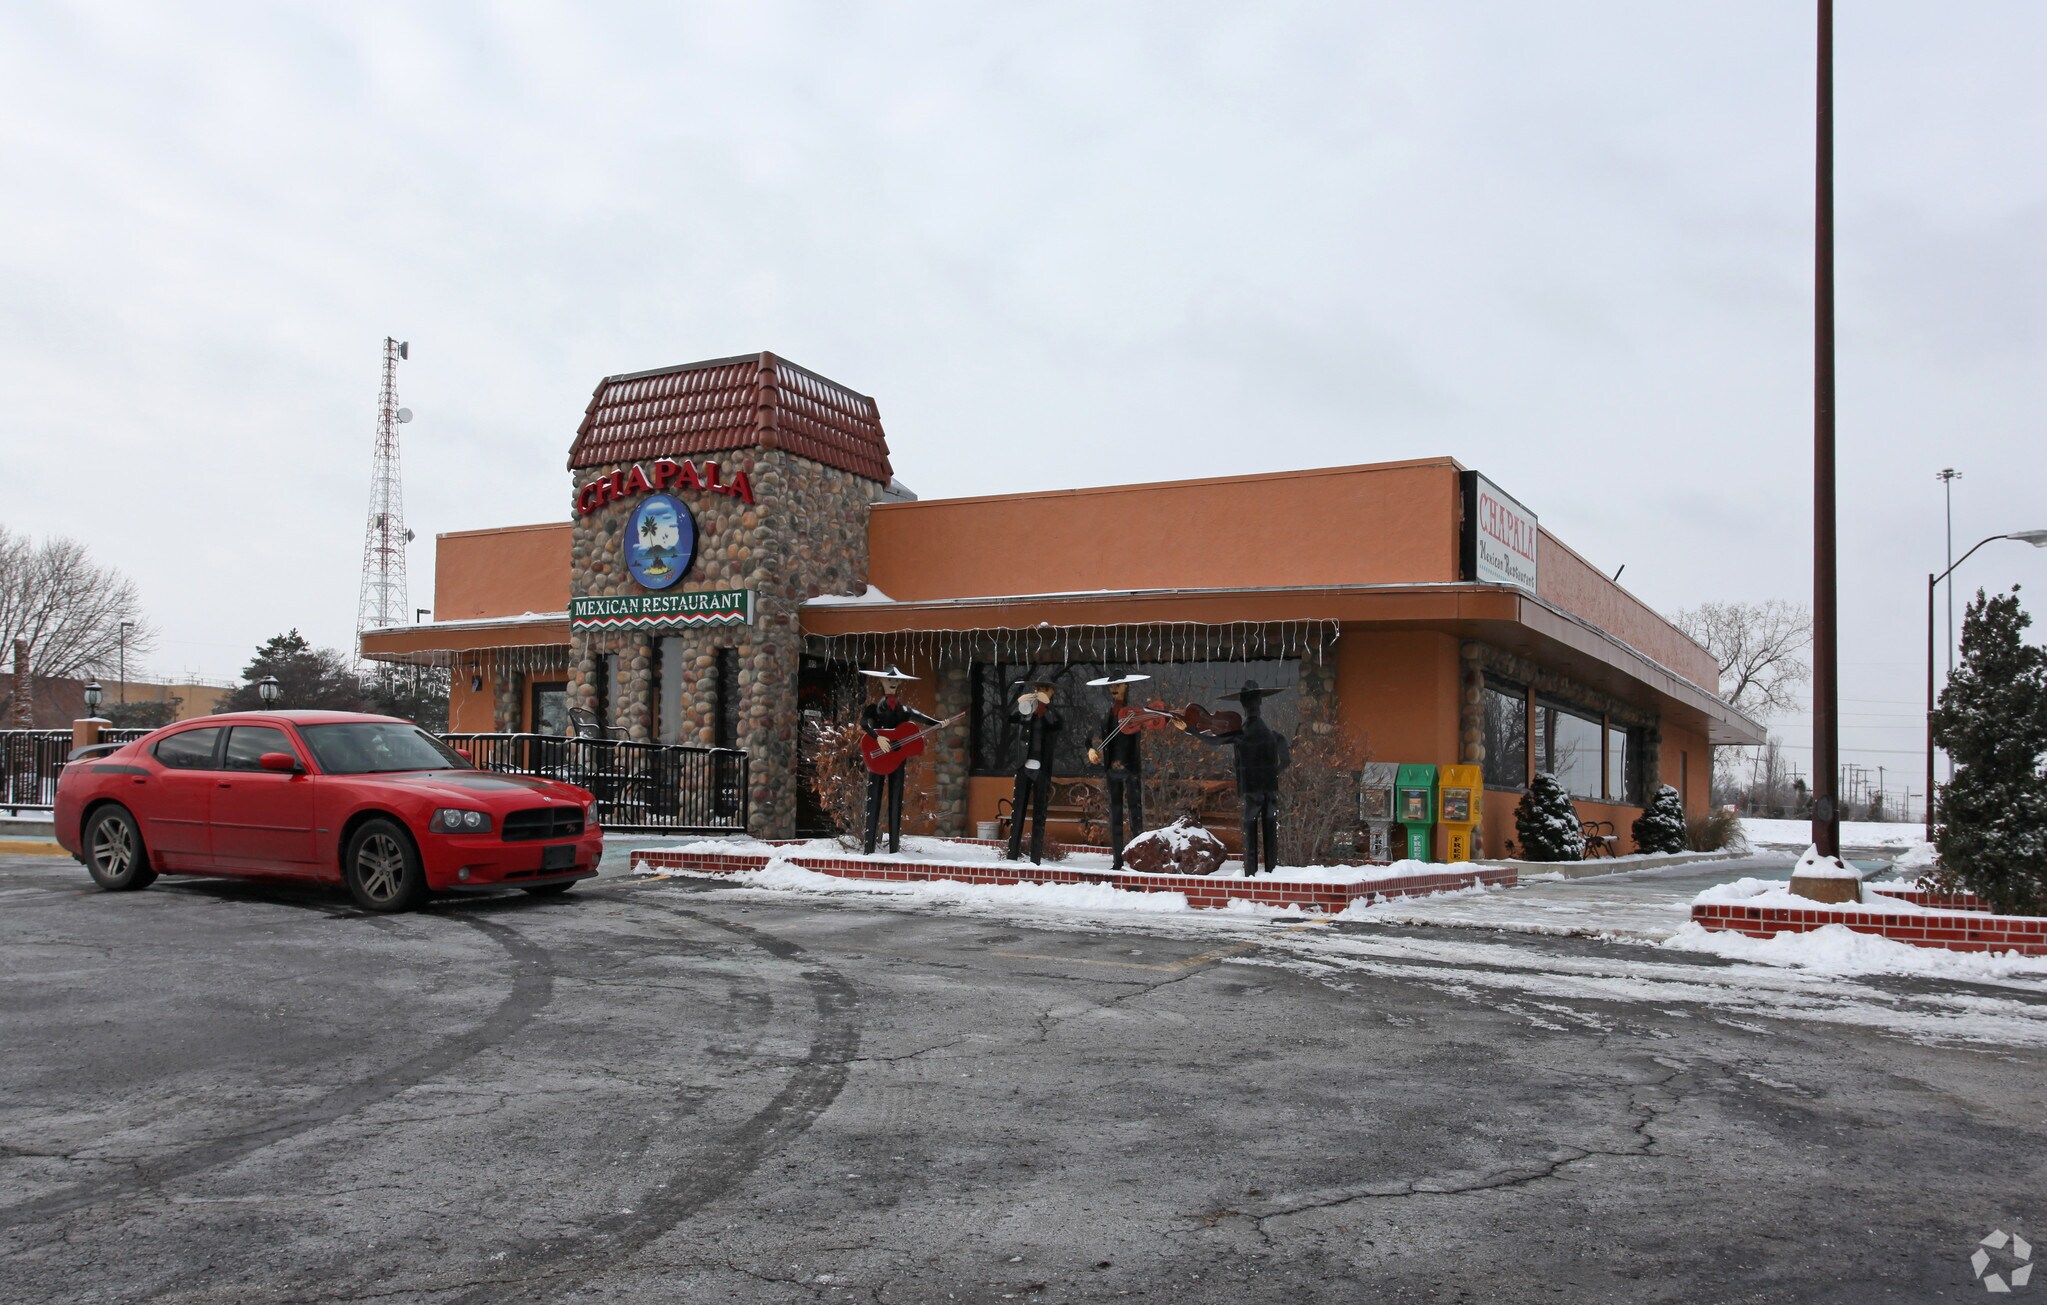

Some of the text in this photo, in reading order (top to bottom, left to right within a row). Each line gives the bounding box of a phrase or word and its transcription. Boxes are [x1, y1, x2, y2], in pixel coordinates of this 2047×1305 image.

[577, 458, 755, 515] CHAPALA
[1480, 492, 1535, 563] CHAPALA
[1480, 540, 1535, 588] Mexican Restaurant
[575, 592, 742, 616] MEXICAN RESTAURANT
[1453, 836, 1462, 859] FREE
